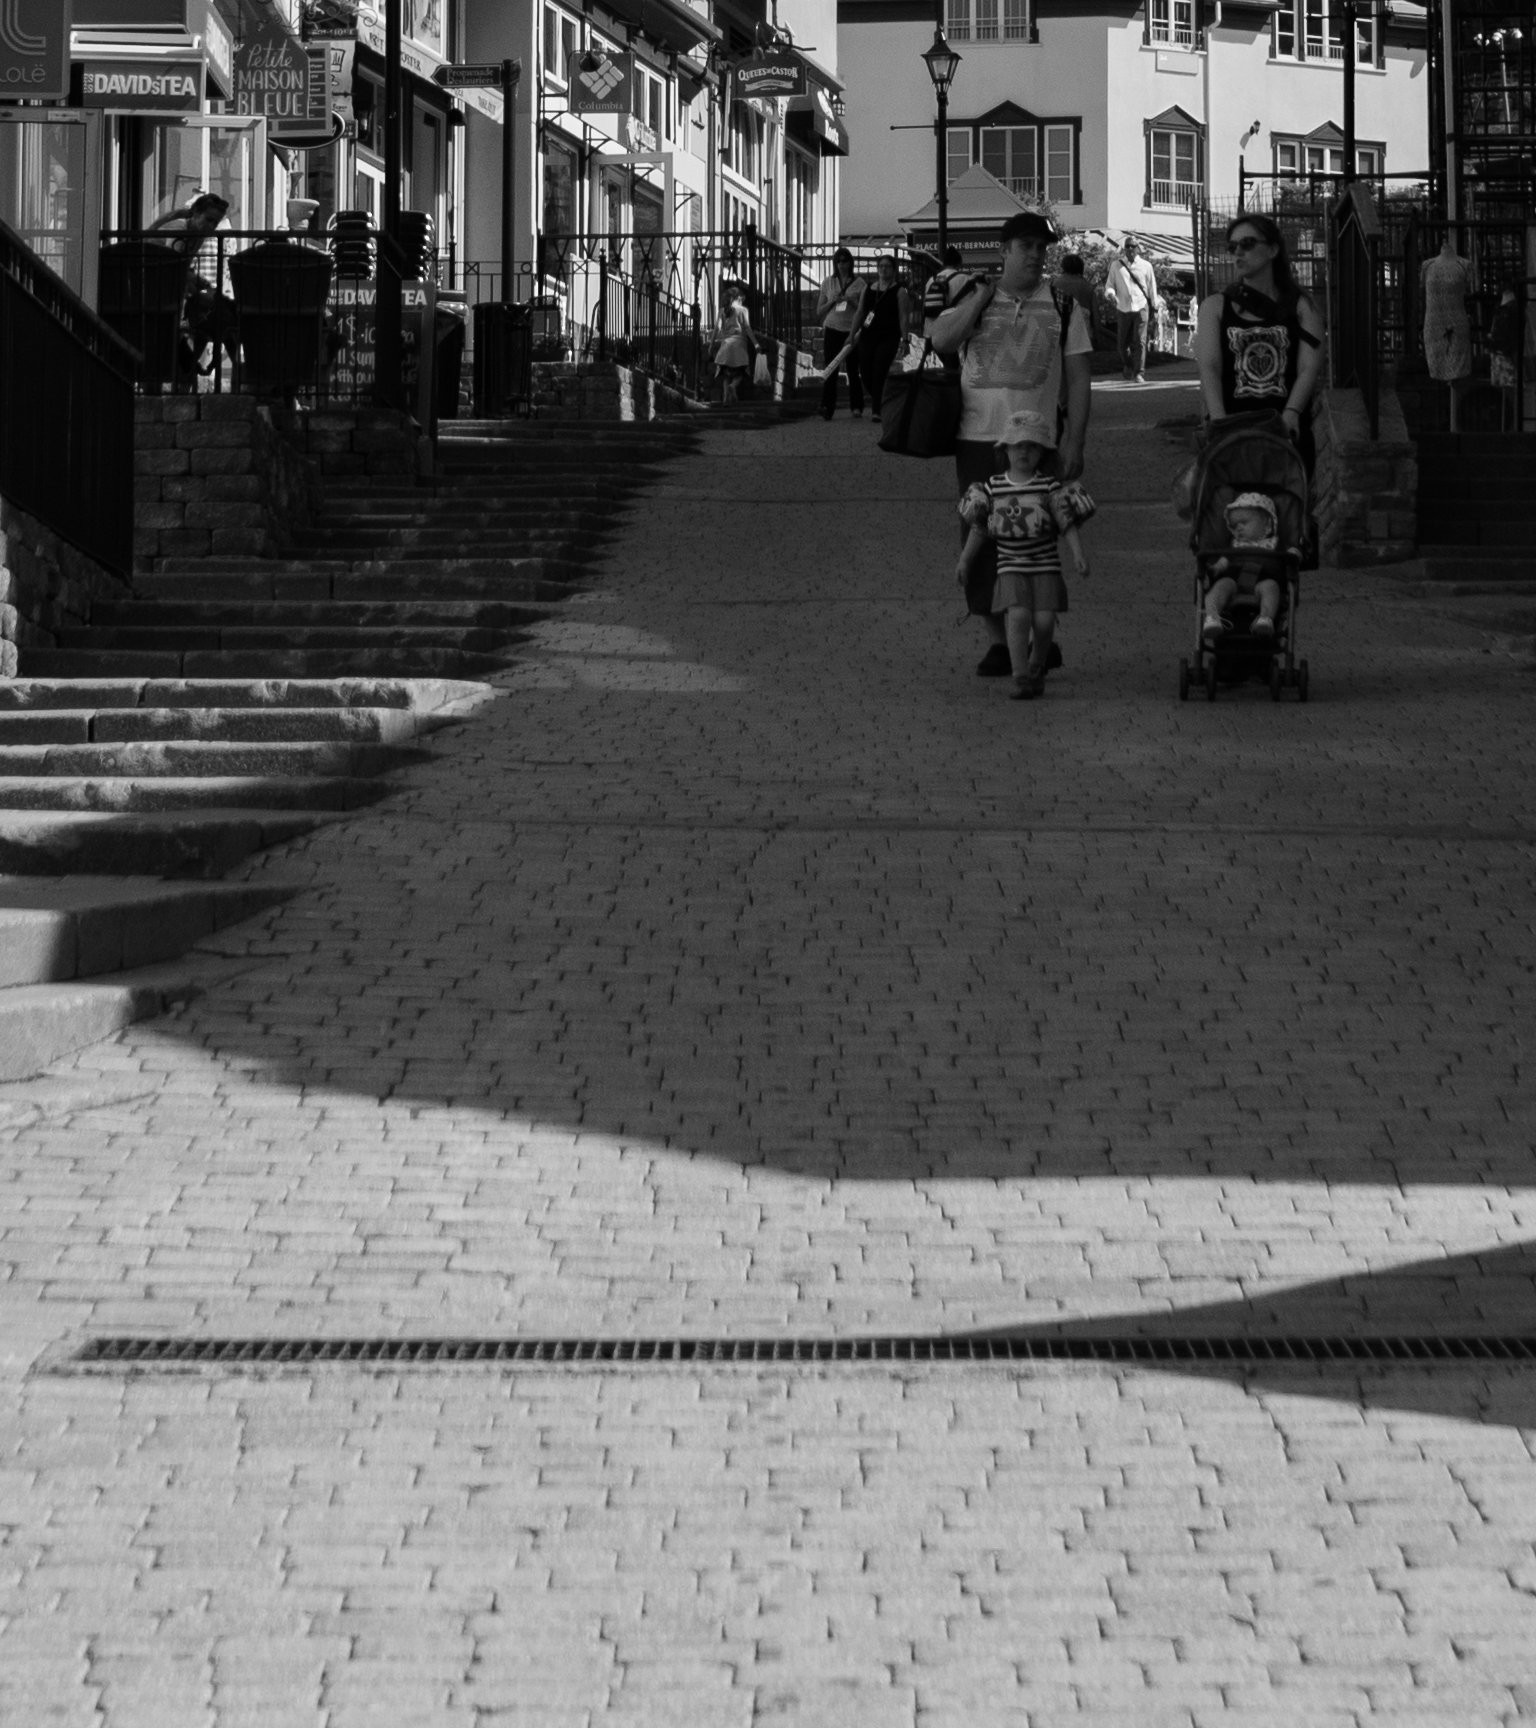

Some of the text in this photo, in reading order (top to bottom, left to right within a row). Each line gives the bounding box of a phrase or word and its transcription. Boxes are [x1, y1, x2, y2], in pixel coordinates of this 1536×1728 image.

[247, 38, 293, 68] Petite
[238, 70, 304, 90] MAISON
[237, 91, 304, 116] BLEUE
[578, 101, 624, 110] Columbia
[915, 243, 938, 251] PLACE
